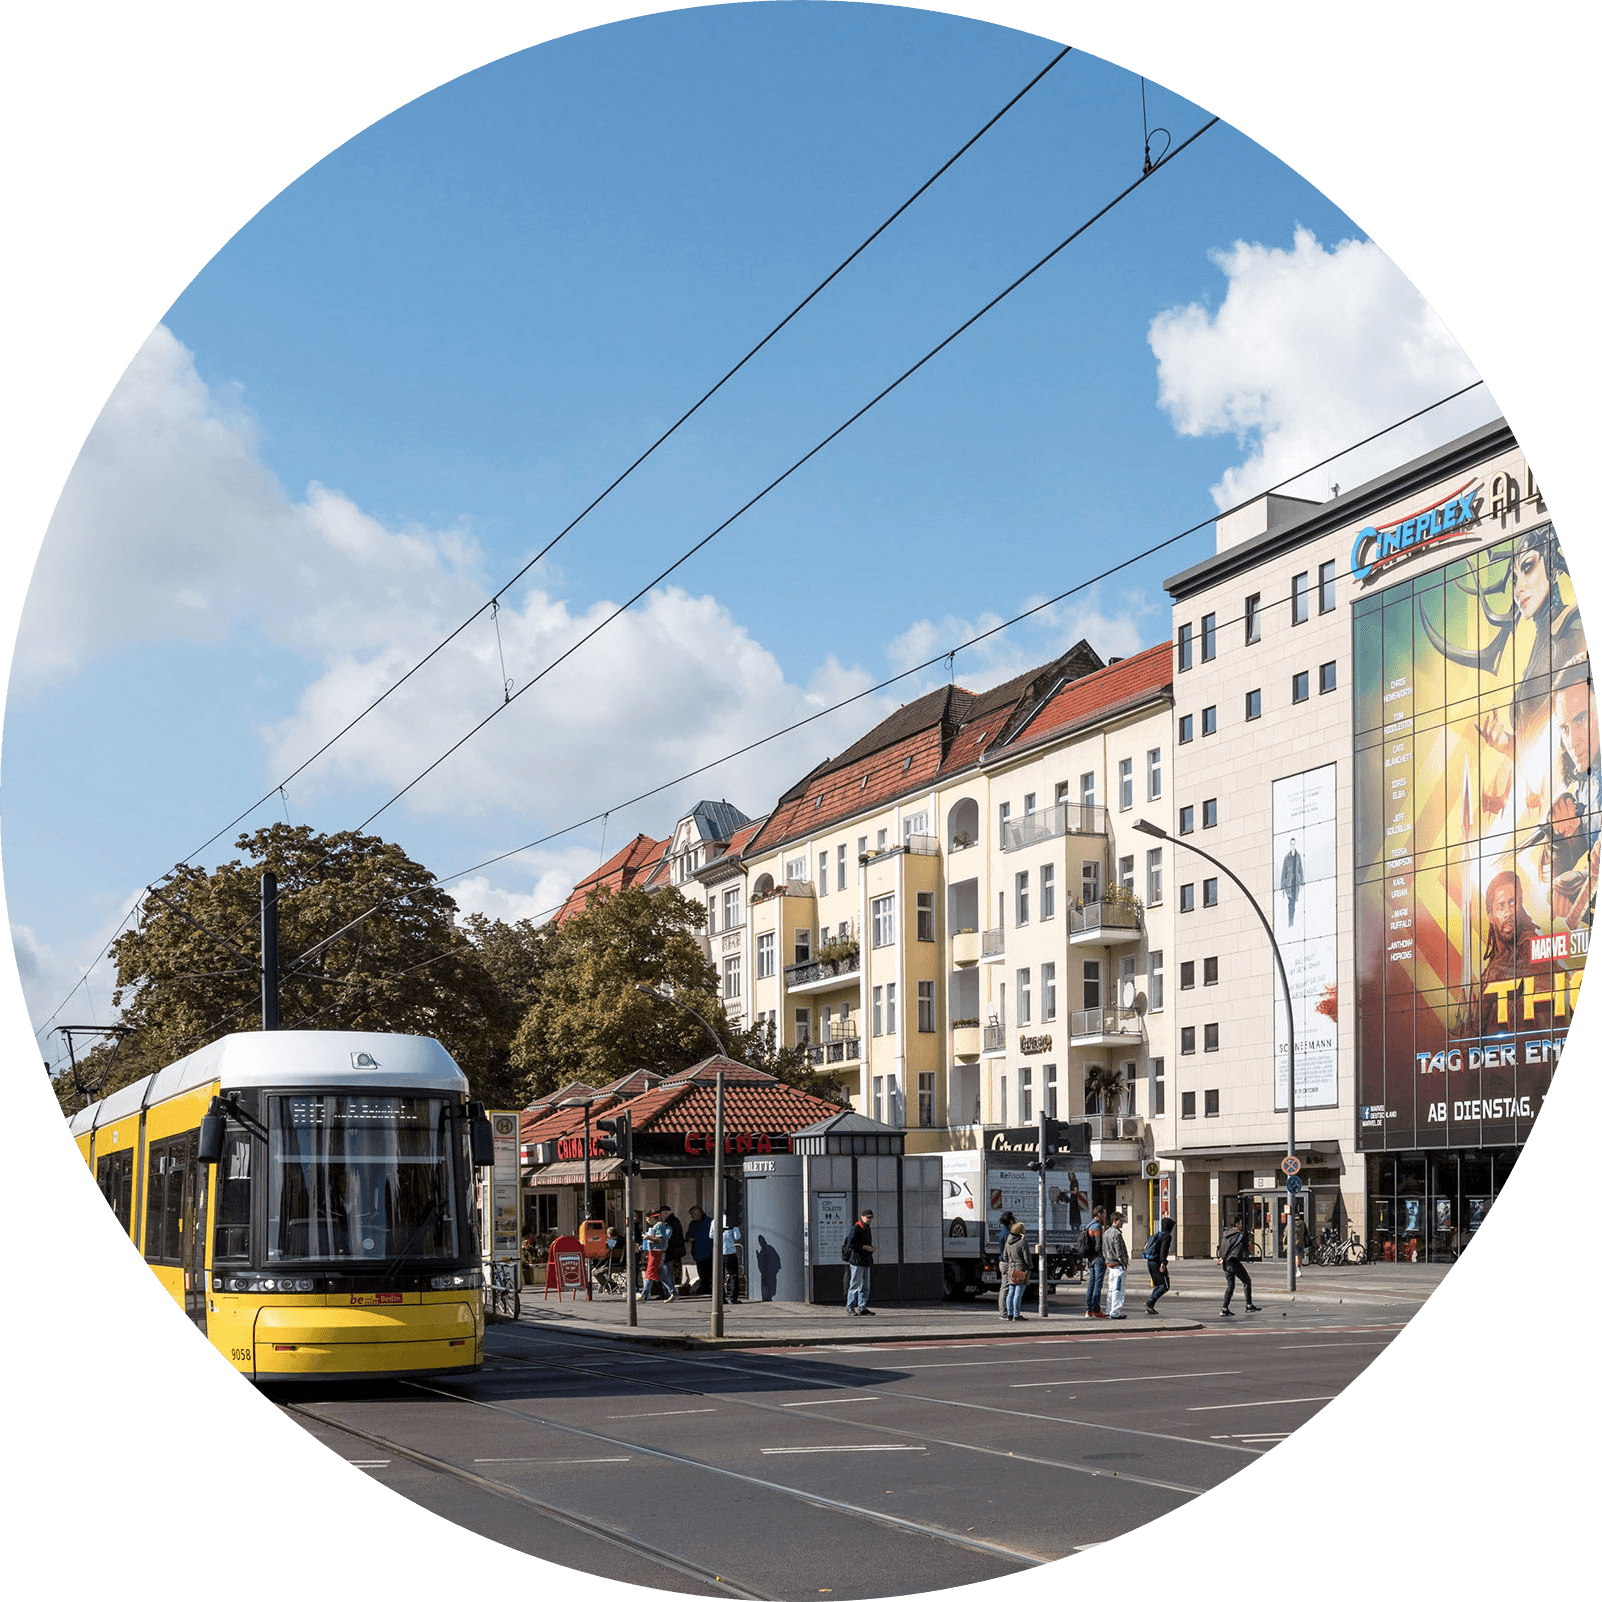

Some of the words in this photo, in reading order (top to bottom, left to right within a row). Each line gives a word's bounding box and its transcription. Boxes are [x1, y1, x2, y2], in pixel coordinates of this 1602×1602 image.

[1351, 491, 1475, 579] CINEPLEX
[1392, 877, 1406, 887] KARL
[1390, 888, 1408, 899] URBAN
[1394, 907, 1408, 918] MARK
[1390, 919, 1412, 930] RUFFALO
[1390, 939, 1413, 950] ANTHONY
[1531, 935, 1568, 961] MARVEL
[1390, 951, 1412, 962] HOPKINS
[1279, 1038, 1332, 1053] SCNEEMANN
[1416, 1049, 1462, 1075] TAG
[1468, 1043, 1518, 1070] DER
[1427, 1102, 1447, 1122] AB
[1454, 1096, 1535, 1121] DIENSTAG,
[557, 1137, 584, 1160] CHINA
[231, 1348, 252, 1361] 9058
